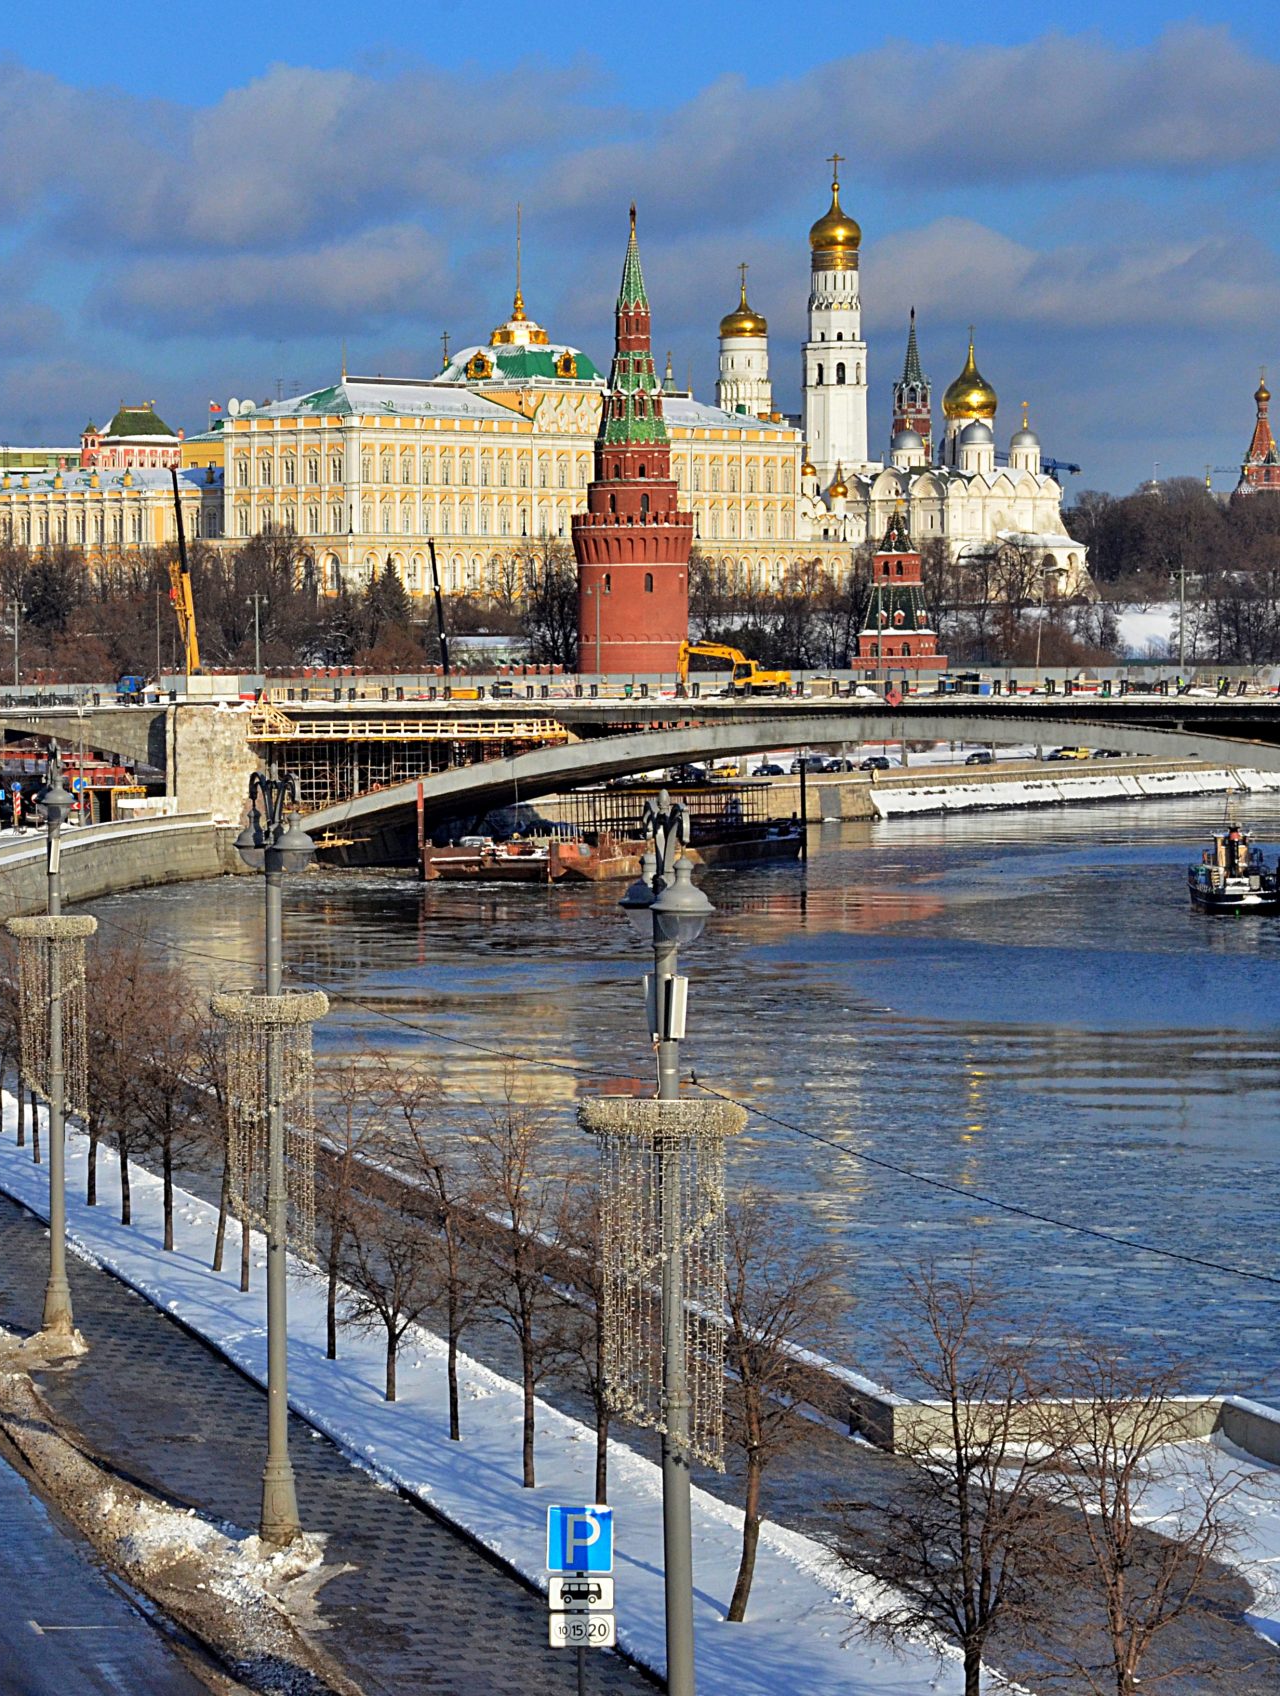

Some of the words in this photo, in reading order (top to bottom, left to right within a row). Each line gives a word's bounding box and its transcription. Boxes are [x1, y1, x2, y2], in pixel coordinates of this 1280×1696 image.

[566, 1513, 601, 1564] P
[558, 1626, 568, 1635] 10
[572, 1624, 583, 1636] 15
[588, 1623, 607, 1637] 20
